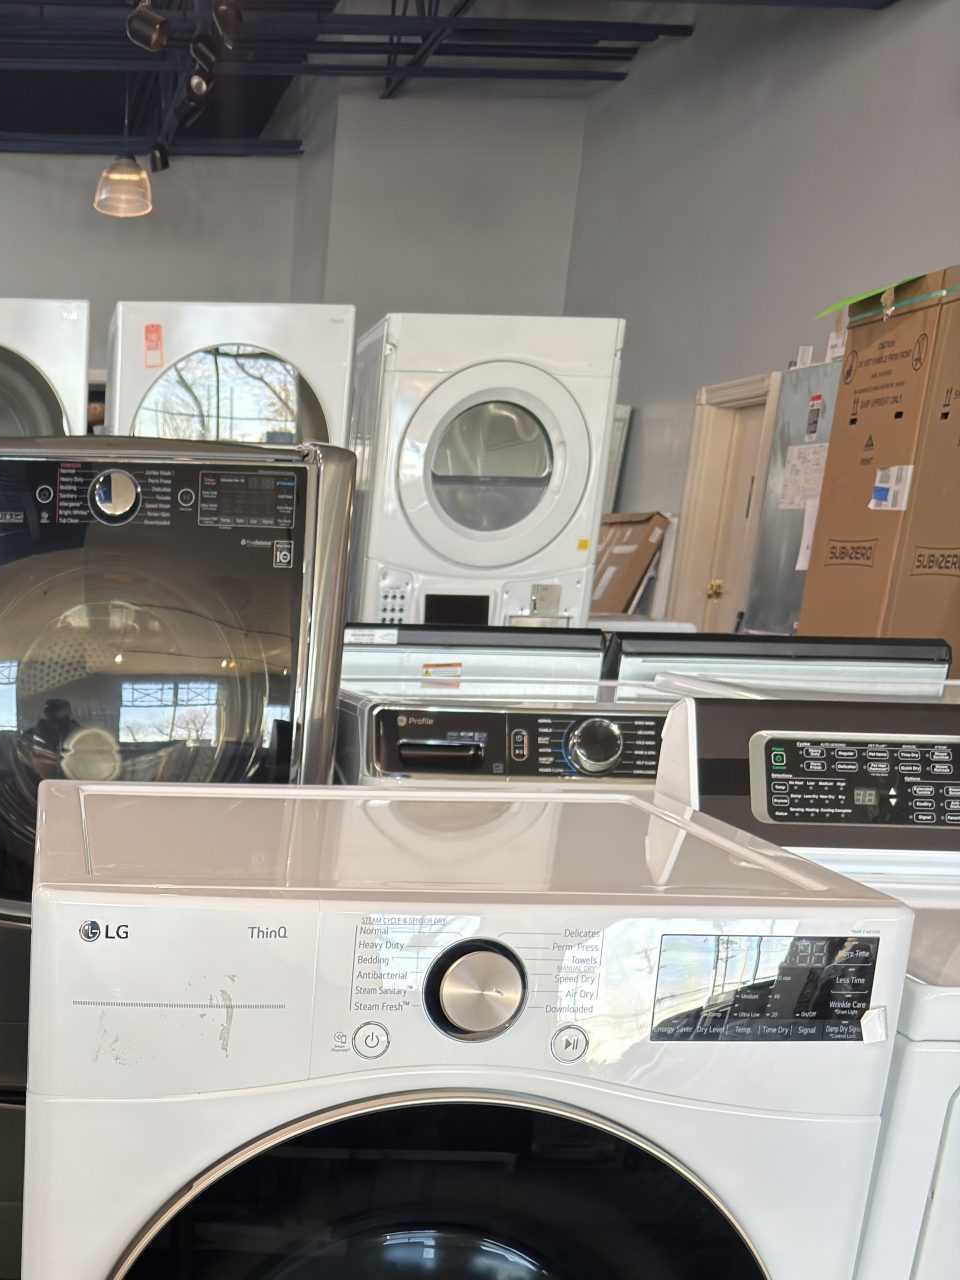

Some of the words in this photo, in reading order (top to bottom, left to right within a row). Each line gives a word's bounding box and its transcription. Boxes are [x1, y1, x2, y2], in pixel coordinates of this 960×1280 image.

[409, 717, 434, 725] Profile
[105, 924, 129, 939] LG
[248, 926, 289, 939] ThinQ
[359, 926, 389, 935] Normal
[564, 929, 600, 938] Delicates
[358, 941, 383, 949] Heavy
[385, 941, 404, 951] Duty
[577, 943, 599, 951] Press
[358, 956, 389, 966] Bedding
[572, 956, 597, 964] Towels
[356, 971, 408, 980] Antibacterial
[554, 975, 578, 984] Speed
[581, 975, 595, 983] Dry
[355, 986, 377, 995] Steam
[566, 990, 577, 998] Air
[580, 990, 594, 1000] Dry
[354, 1002, 379, 1011] Steam
[545, 1005, 593, 1013] Downloaded
[697, 1026, 708, 1035] Dry
[798, 1026, 816, 1035] Signal
